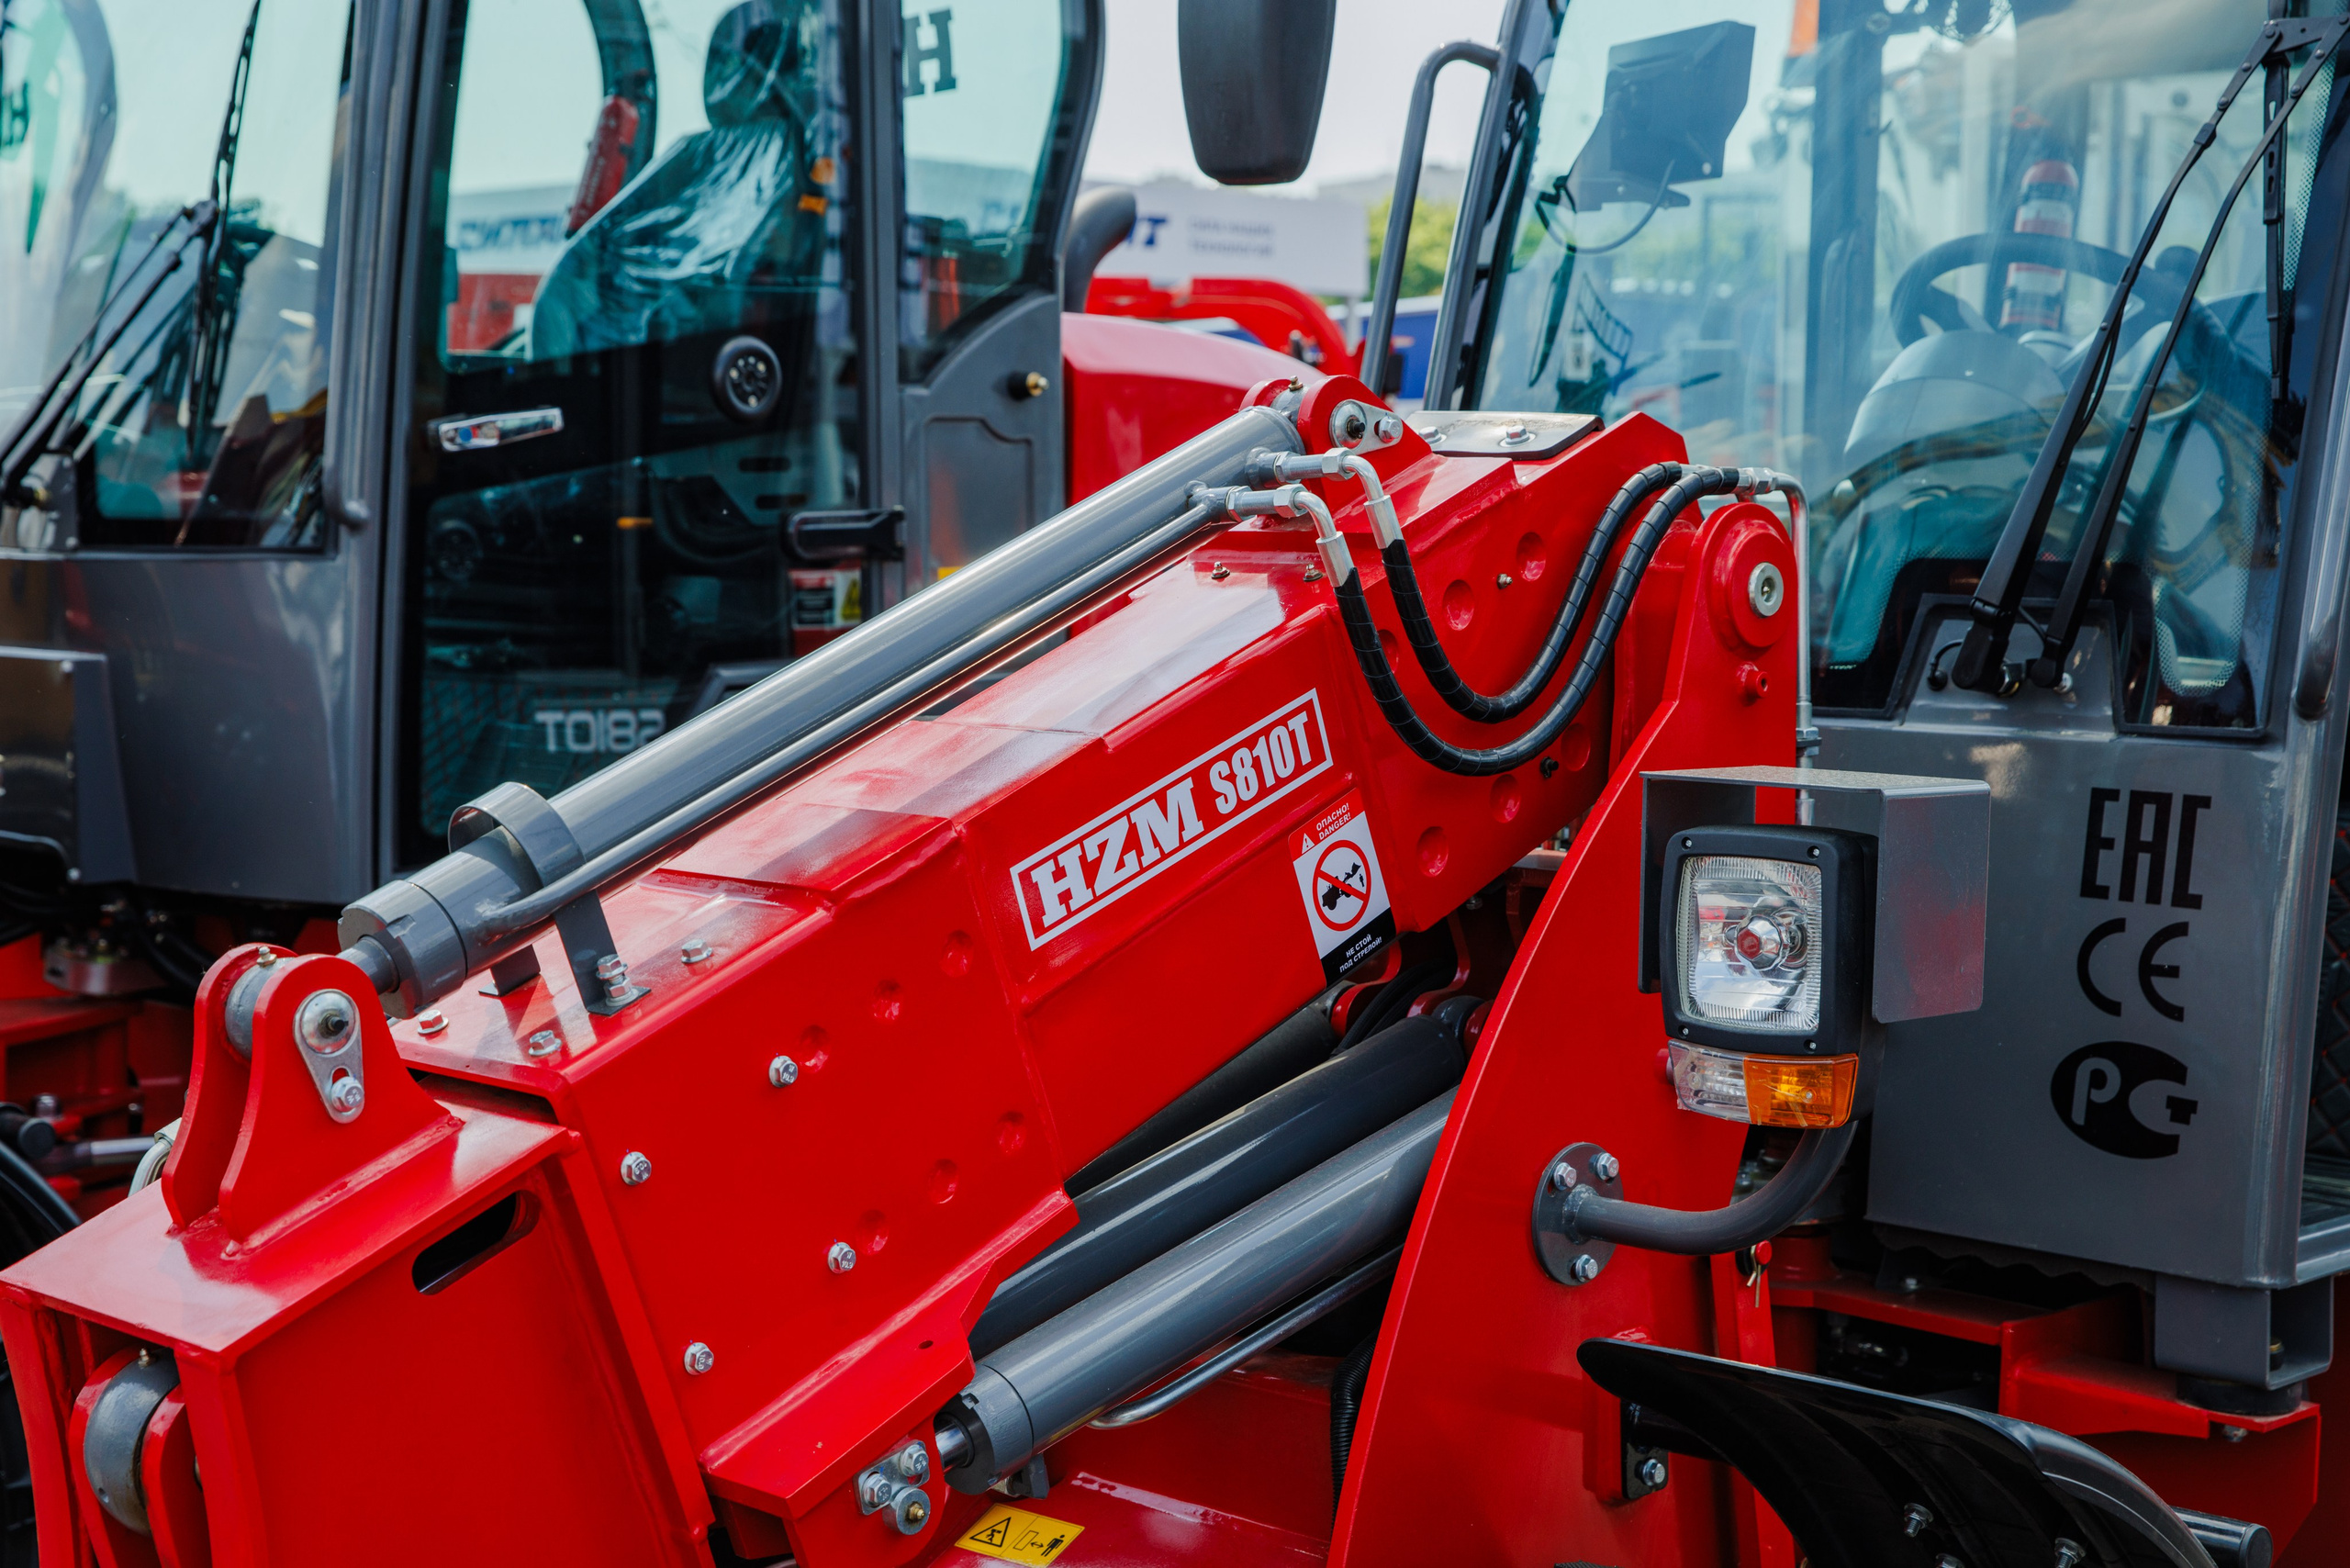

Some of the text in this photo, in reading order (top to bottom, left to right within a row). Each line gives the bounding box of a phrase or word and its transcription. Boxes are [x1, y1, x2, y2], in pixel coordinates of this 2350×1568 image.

[1031, 711, 1312, 928] HZM S810T
[1316, 802, 1349, 831] ОПАСНО!
[1318, 812, 1351, 840] DANGER!
[2080, 787, 2212, 910] EAC
[1339, 936, 1382, 973] ПОД СТРЕЛОЙ!
[1346, 934, 1372, 958] НЕ СТОЙ
[2076, 917, 2190, 1022] CE
